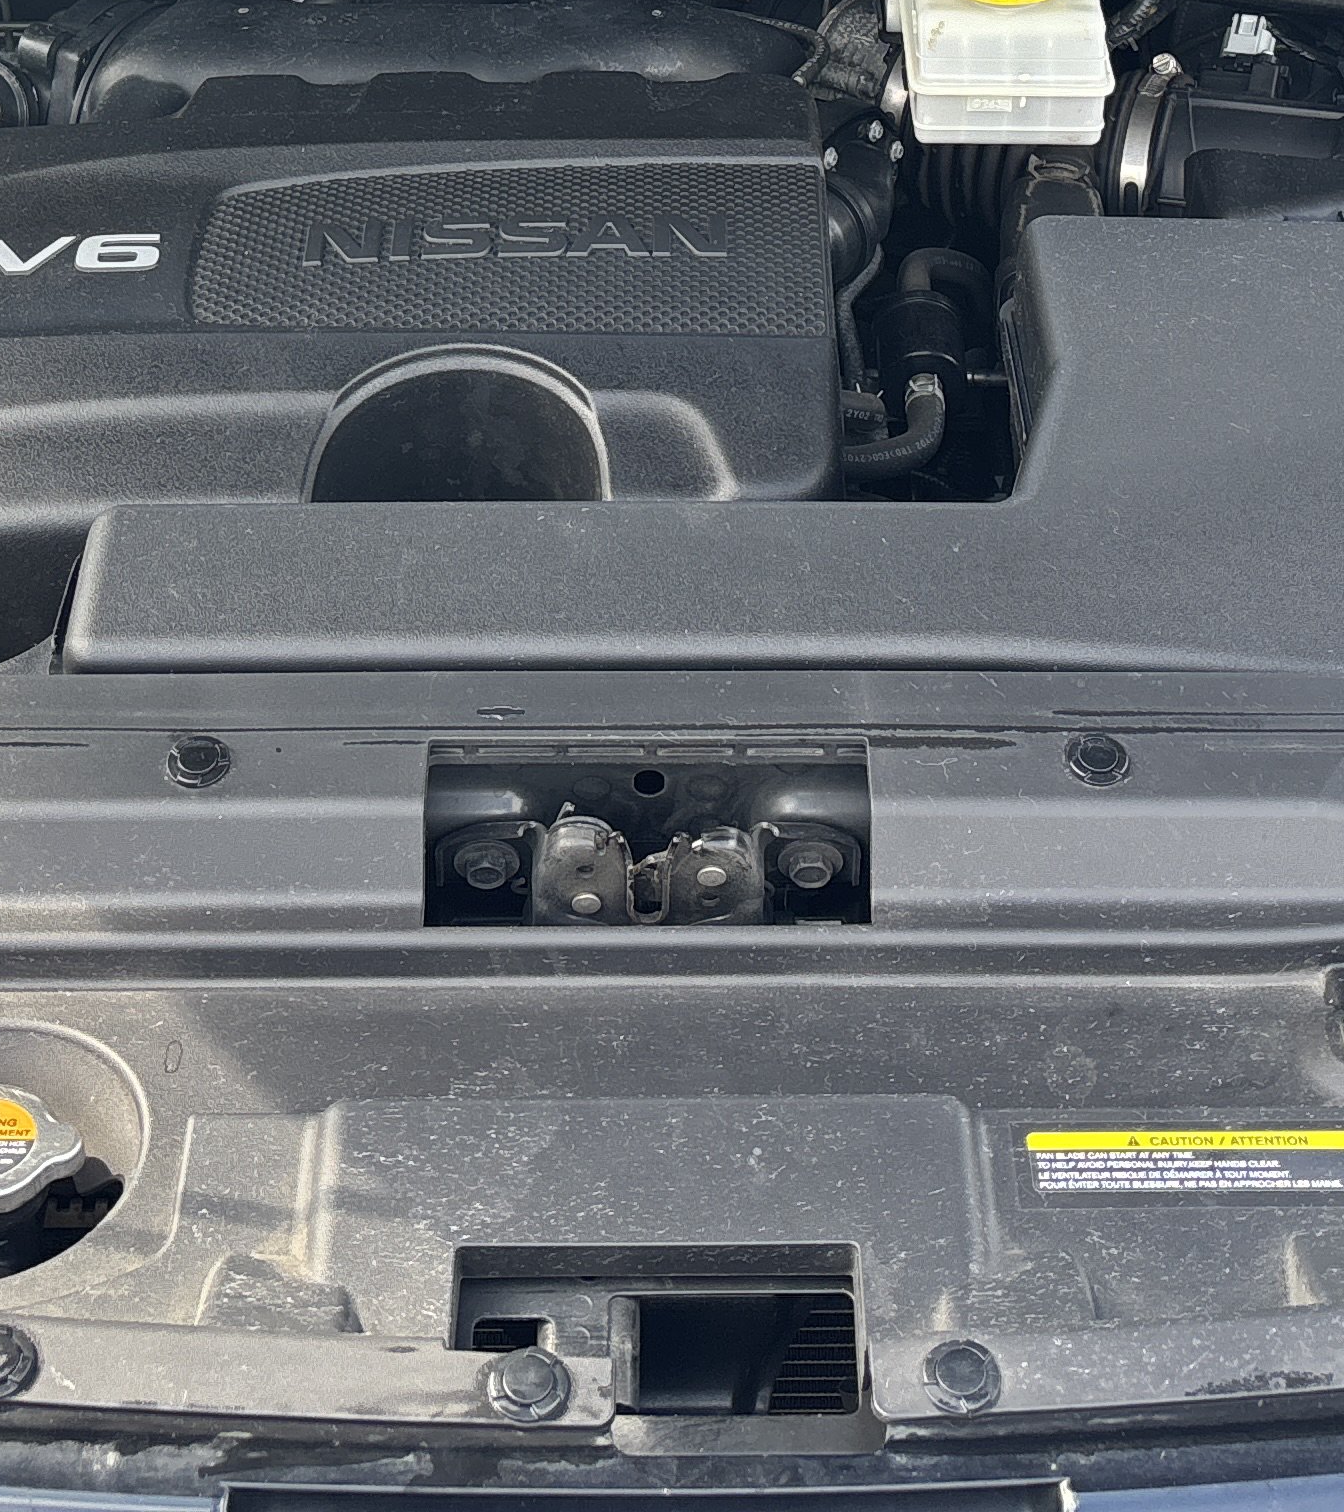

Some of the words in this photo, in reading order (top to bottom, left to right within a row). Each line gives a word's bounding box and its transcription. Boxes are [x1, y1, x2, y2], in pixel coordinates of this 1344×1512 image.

[302, 214, 728, 267] NISSAN
[1150, 1136, 1214, 1146] CAUTION
[1219, 1136, 1225, 1146] /
[1230, 1136, 1309, 1145] ATTENTION
[1038, 1171, 1050, 1179] LE
[1051, 1171, 1111, 1179] VENTILATEUR
[1148, 1171, 1162, 1179] DE
[1223, 1171, 1247, 1179] TOUT
[1040, 1180, 1067, 1188] POUR
[1101, 1180, 1131, 1188] TOUTE
[1184, 1180, 1197, 1188] NE
[1199, 1180, 1217, 1188] PAS
[1219, 1180, 1232, 1188] EN
[1233, 1180, 1291, 1188] APPROCHER
[1292, 1180, 1310, 1188] LES
